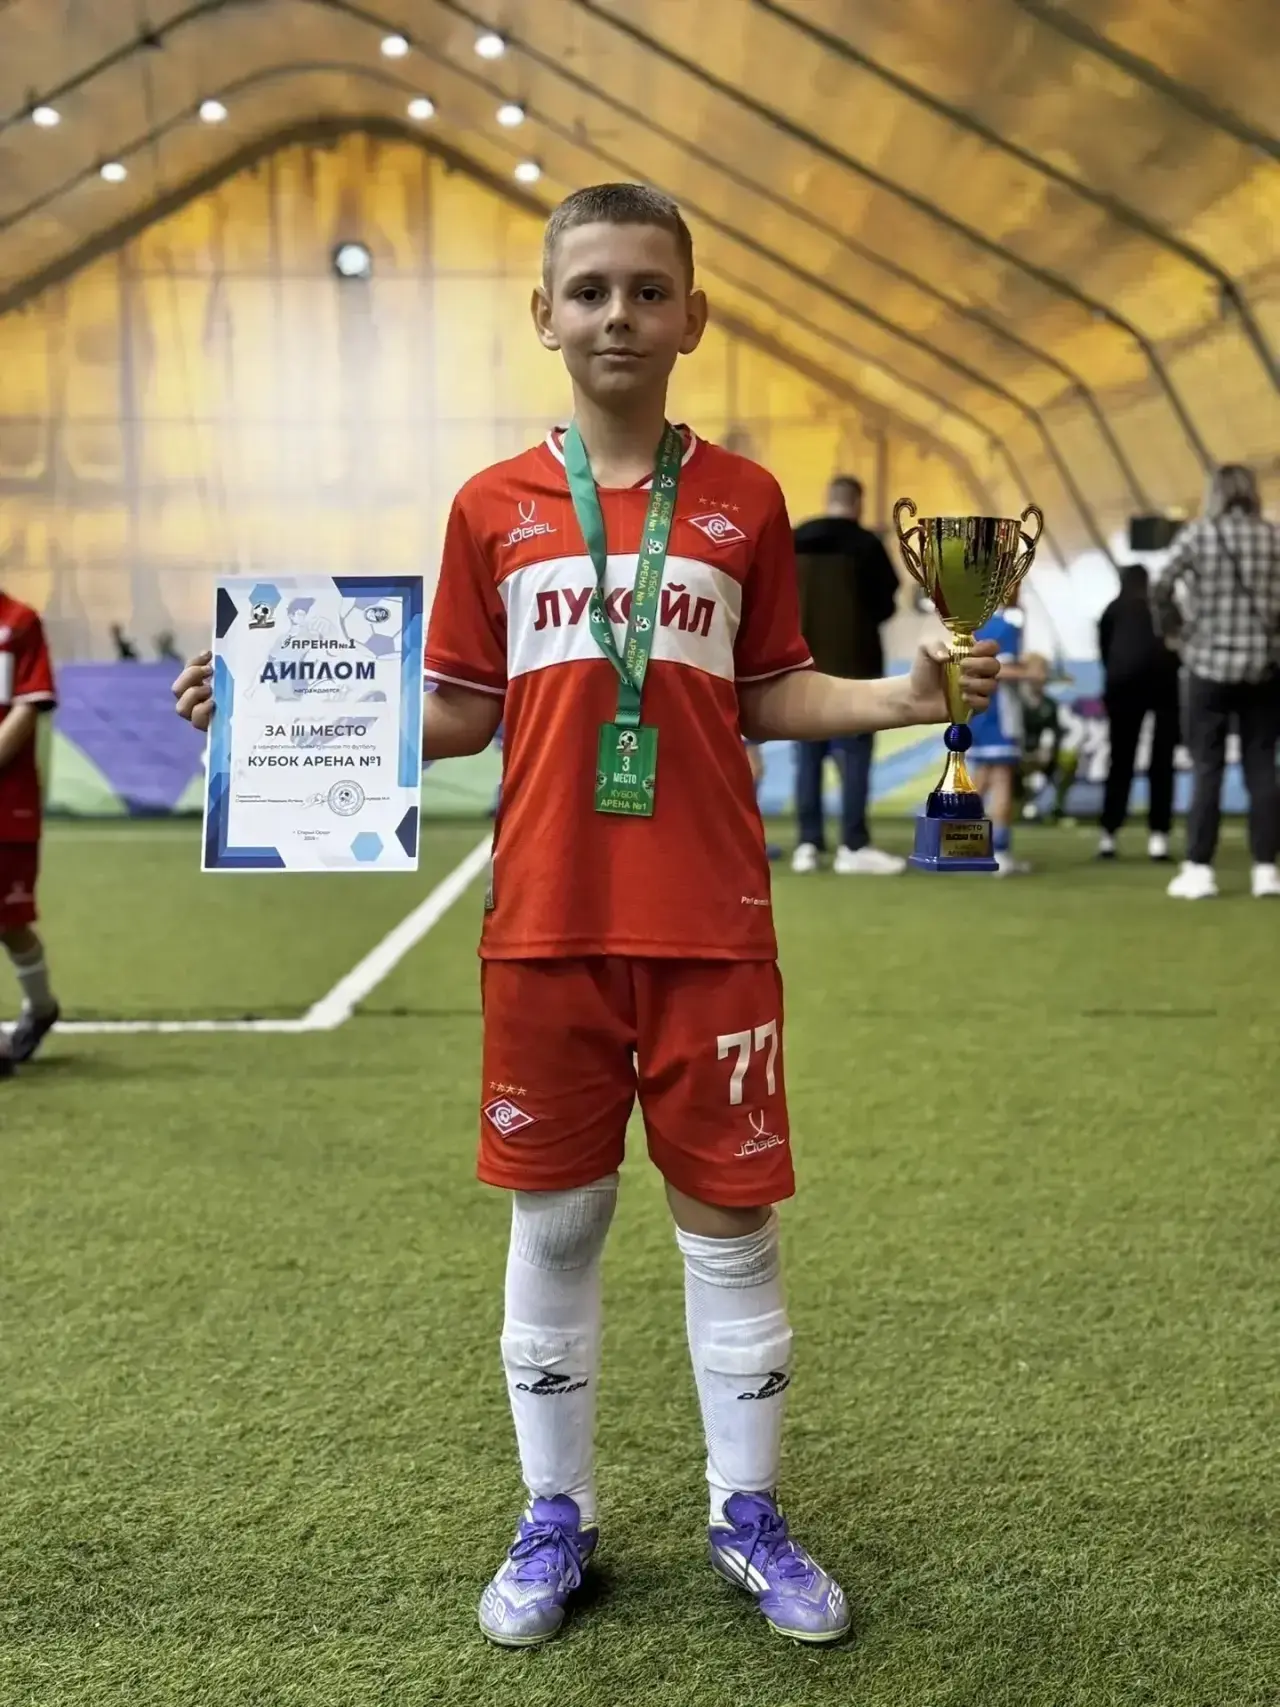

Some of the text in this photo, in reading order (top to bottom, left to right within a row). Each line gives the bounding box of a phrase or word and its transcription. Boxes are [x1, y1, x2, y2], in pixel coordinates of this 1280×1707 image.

[650, 491, 663, 518] АРЕНА
[502, 522, 557, 547] JÖGEL
[639, 559, 650, 588] АРЕНА
[260, 660, 376, 683] ДИПЛОМ
[264, 725, 286, 737] ЗА
[310, 725, 367, 737] МЕСТО
[248, 756, 382, 767] КУБОК АРЕНА №1
[622, 755, 631, 772] 3
[612, 772, 638, 785] МЕСТО
[600, 799, 631, 809] АРЕНА
[610, 789, 640, 800] КУБОК
[716, 1018, 779, 1106] 77
[733, 1135, 786, 1157] JÖGEL
[483, 1587, 506, 1626] 50
[827, 1582, 844, 1619] F5
